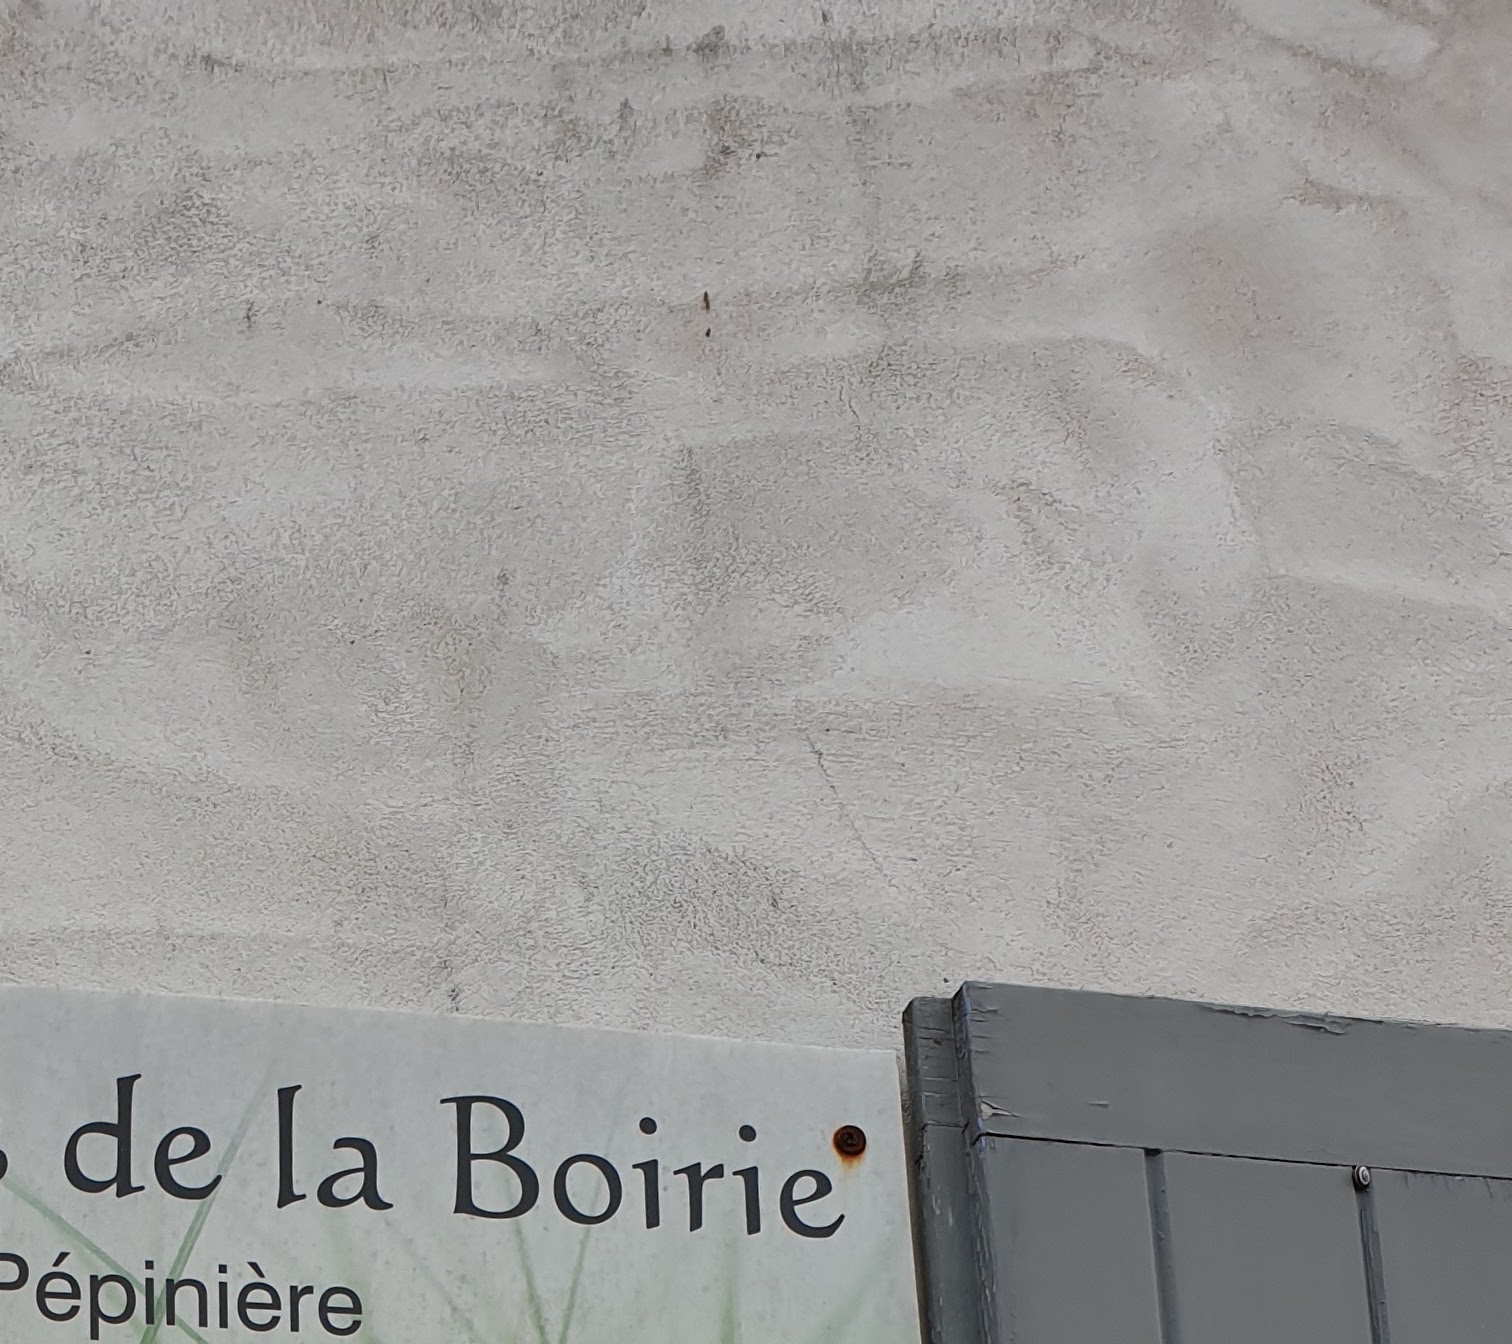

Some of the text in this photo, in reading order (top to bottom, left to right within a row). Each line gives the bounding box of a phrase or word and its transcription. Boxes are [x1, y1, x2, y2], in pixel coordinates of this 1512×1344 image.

[63, 1073, 223, 1200] de
[276, 1084, 393, 1211] la
[439, 1095, 846, 1240] Boirie
